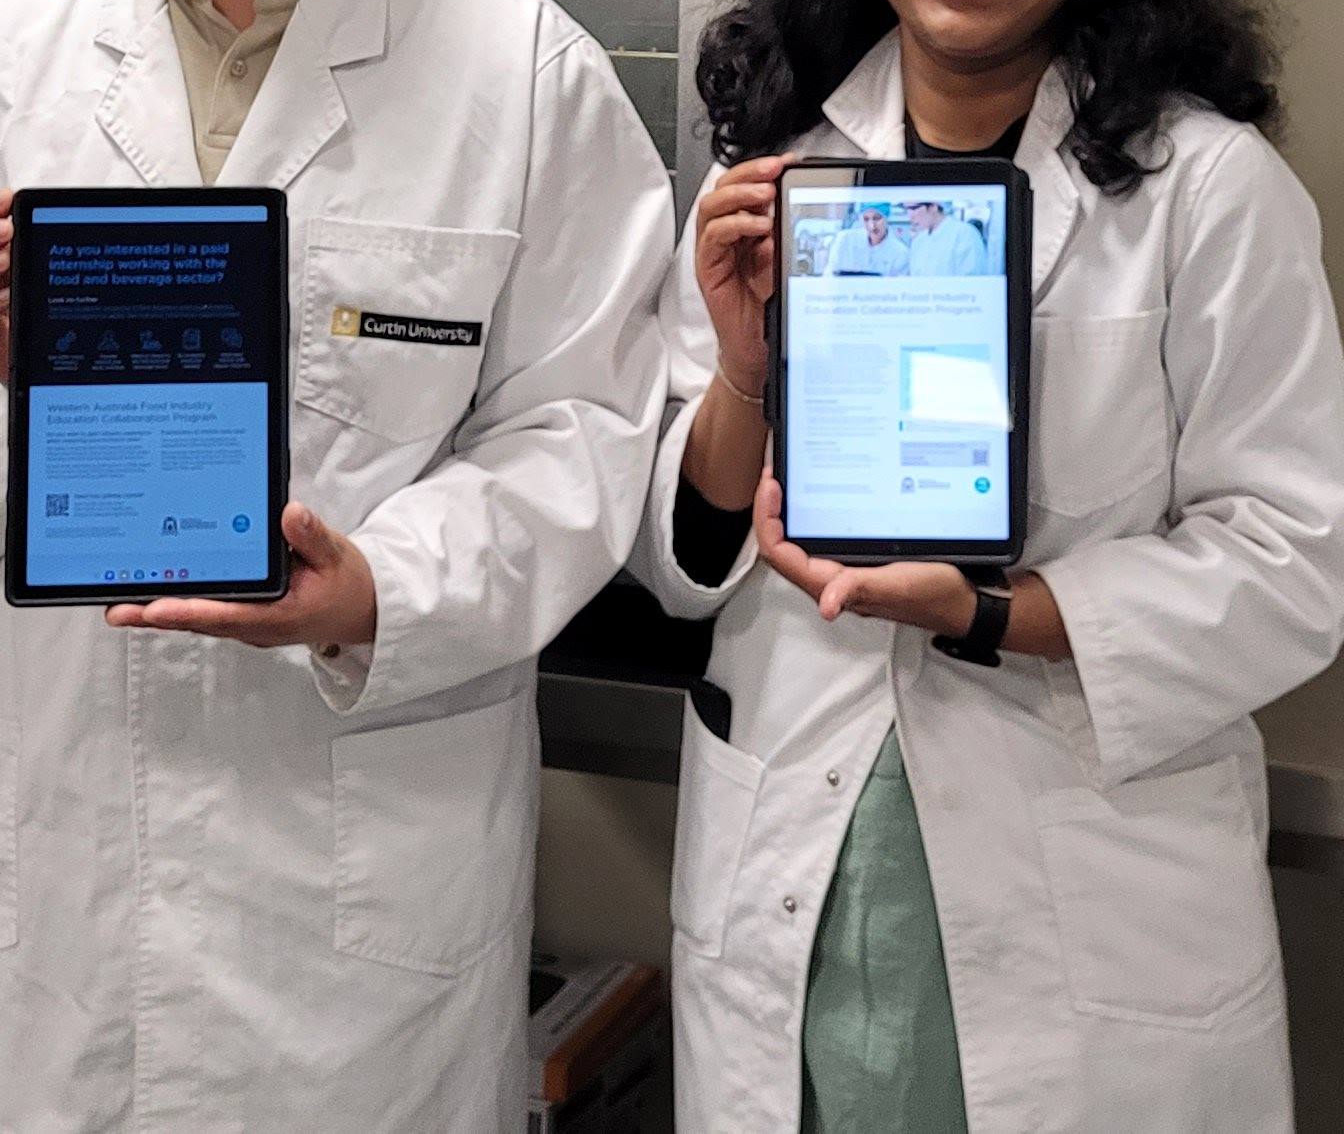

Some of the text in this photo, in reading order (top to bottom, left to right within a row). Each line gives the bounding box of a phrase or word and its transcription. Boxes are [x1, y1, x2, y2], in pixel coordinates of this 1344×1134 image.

[49, 243, 230, 257] Are you interested in a paid
[49, 258, 227, 271] internship working with the
[49, 272, 224, 286] food and beverage sector?
[852, 293, 898, 303] Australia
[901, 292, 930, 302] Food
[933, 292, 976, 304] Industry
[364, 318, 473, 344] Curtin University
